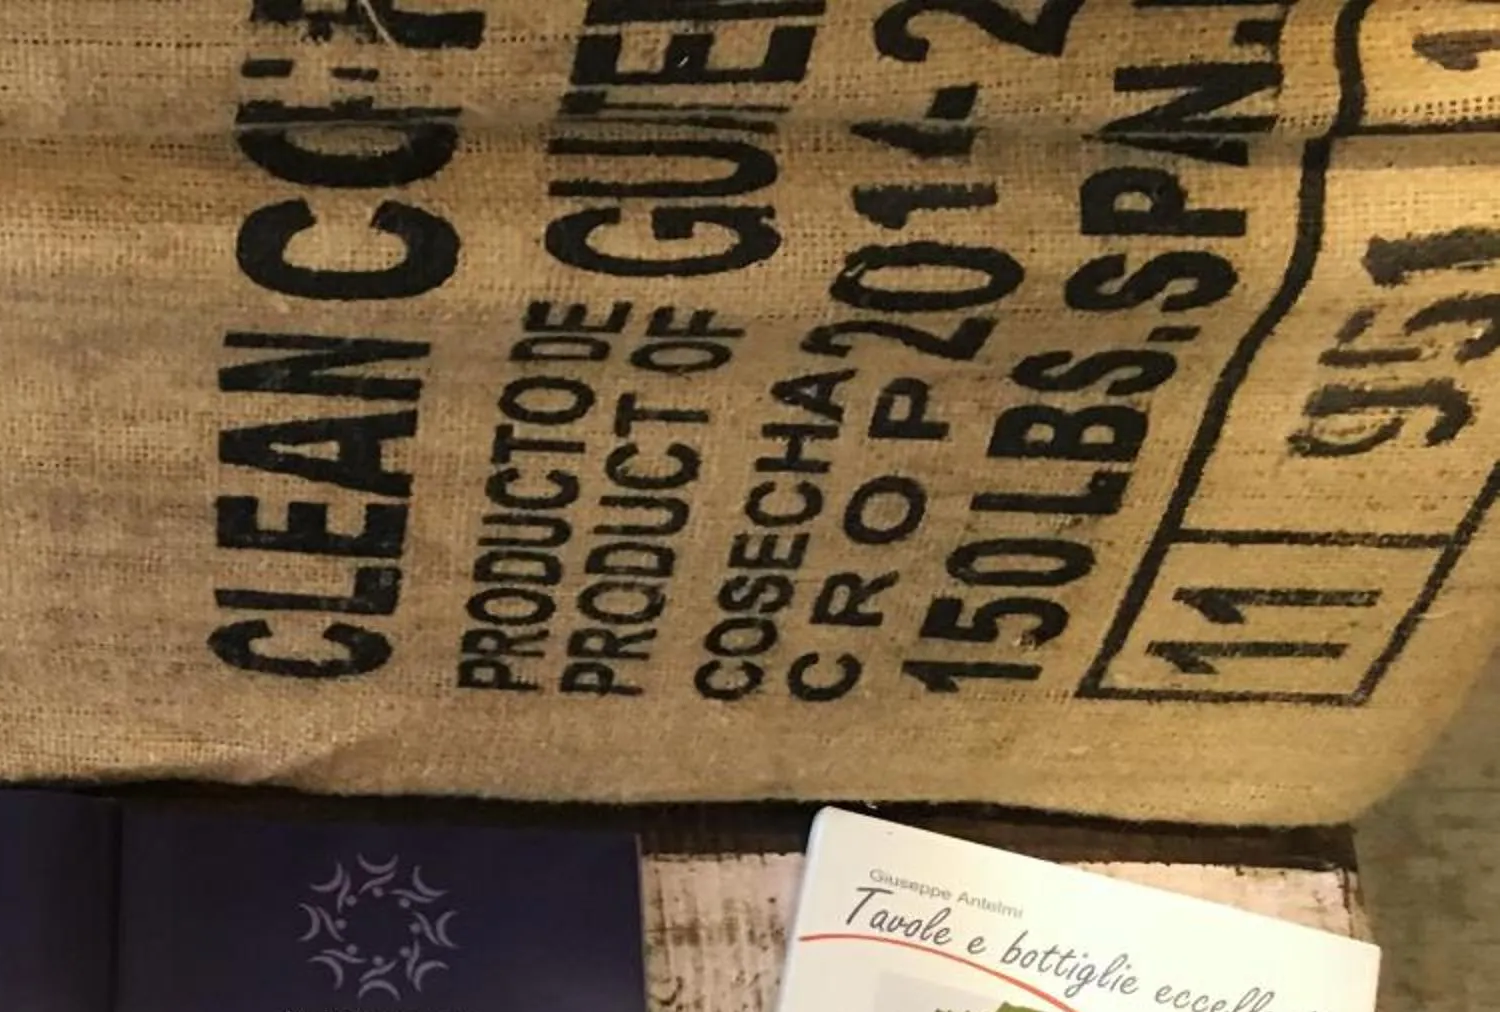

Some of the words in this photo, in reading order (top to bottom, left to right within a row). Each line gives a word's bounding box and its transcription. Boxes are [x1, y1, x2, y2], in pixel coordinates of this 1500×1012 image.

[508, 302, 632, 361] DE
[629, 306, 745, 372] OF
[208, 329, 431, 678] CLEAN
[456, 376, 597, 691] PRODUCTO
[559, 392, 709, 696] PRODUCT
[694, 368, 857, 700] COSECHA
[788, 377, 950, 700] CROP
[844, 887, 952, 947] Tavole
[967, 933, 987, 955] e
[999, 930, 1139, 998] bottiglie
[869, 868, 952, 902] Giuseppe
[956, 890, 1024, 919] Antelmi
